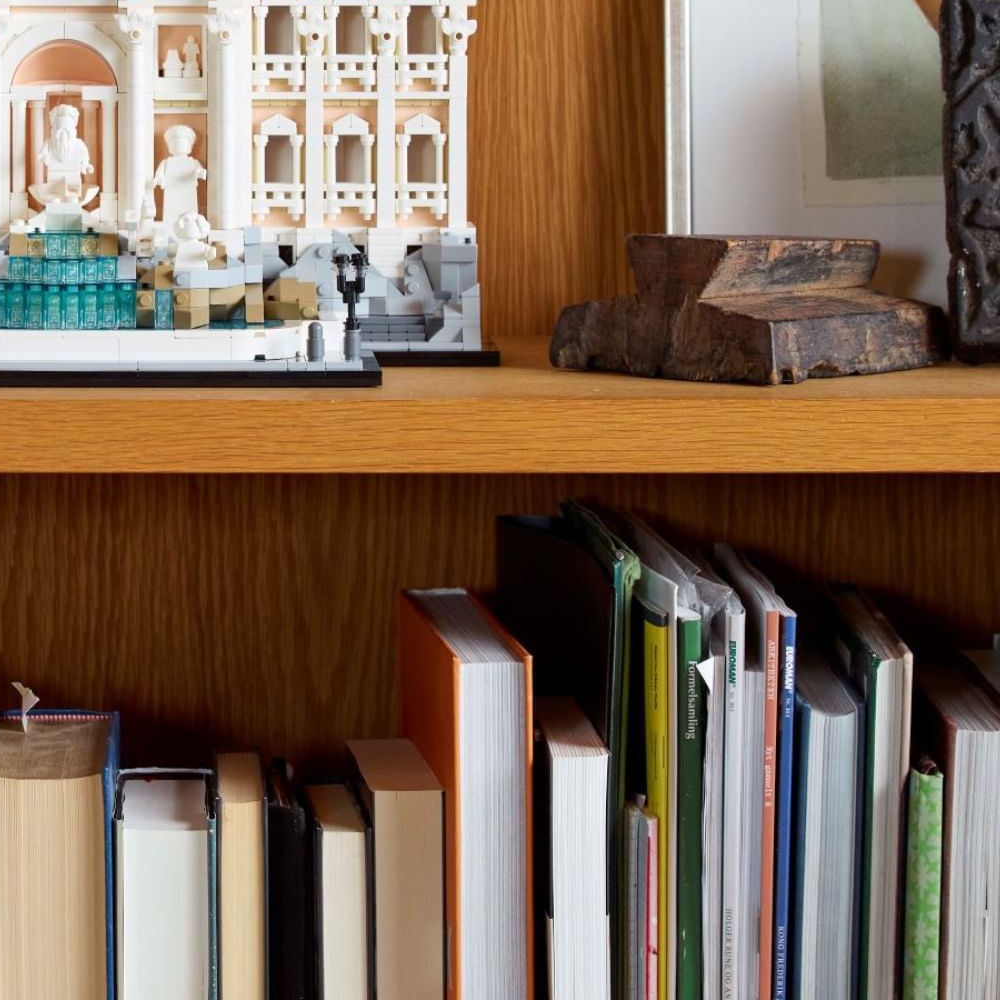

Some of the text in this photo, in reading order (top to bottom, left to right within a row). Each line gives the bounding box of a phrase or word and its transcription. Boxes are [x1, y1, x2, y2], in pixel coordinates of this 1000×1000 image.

[685, 660, 698, 739] Formelsamling
[775, 926, 785, 995] KONG FREDERIK
